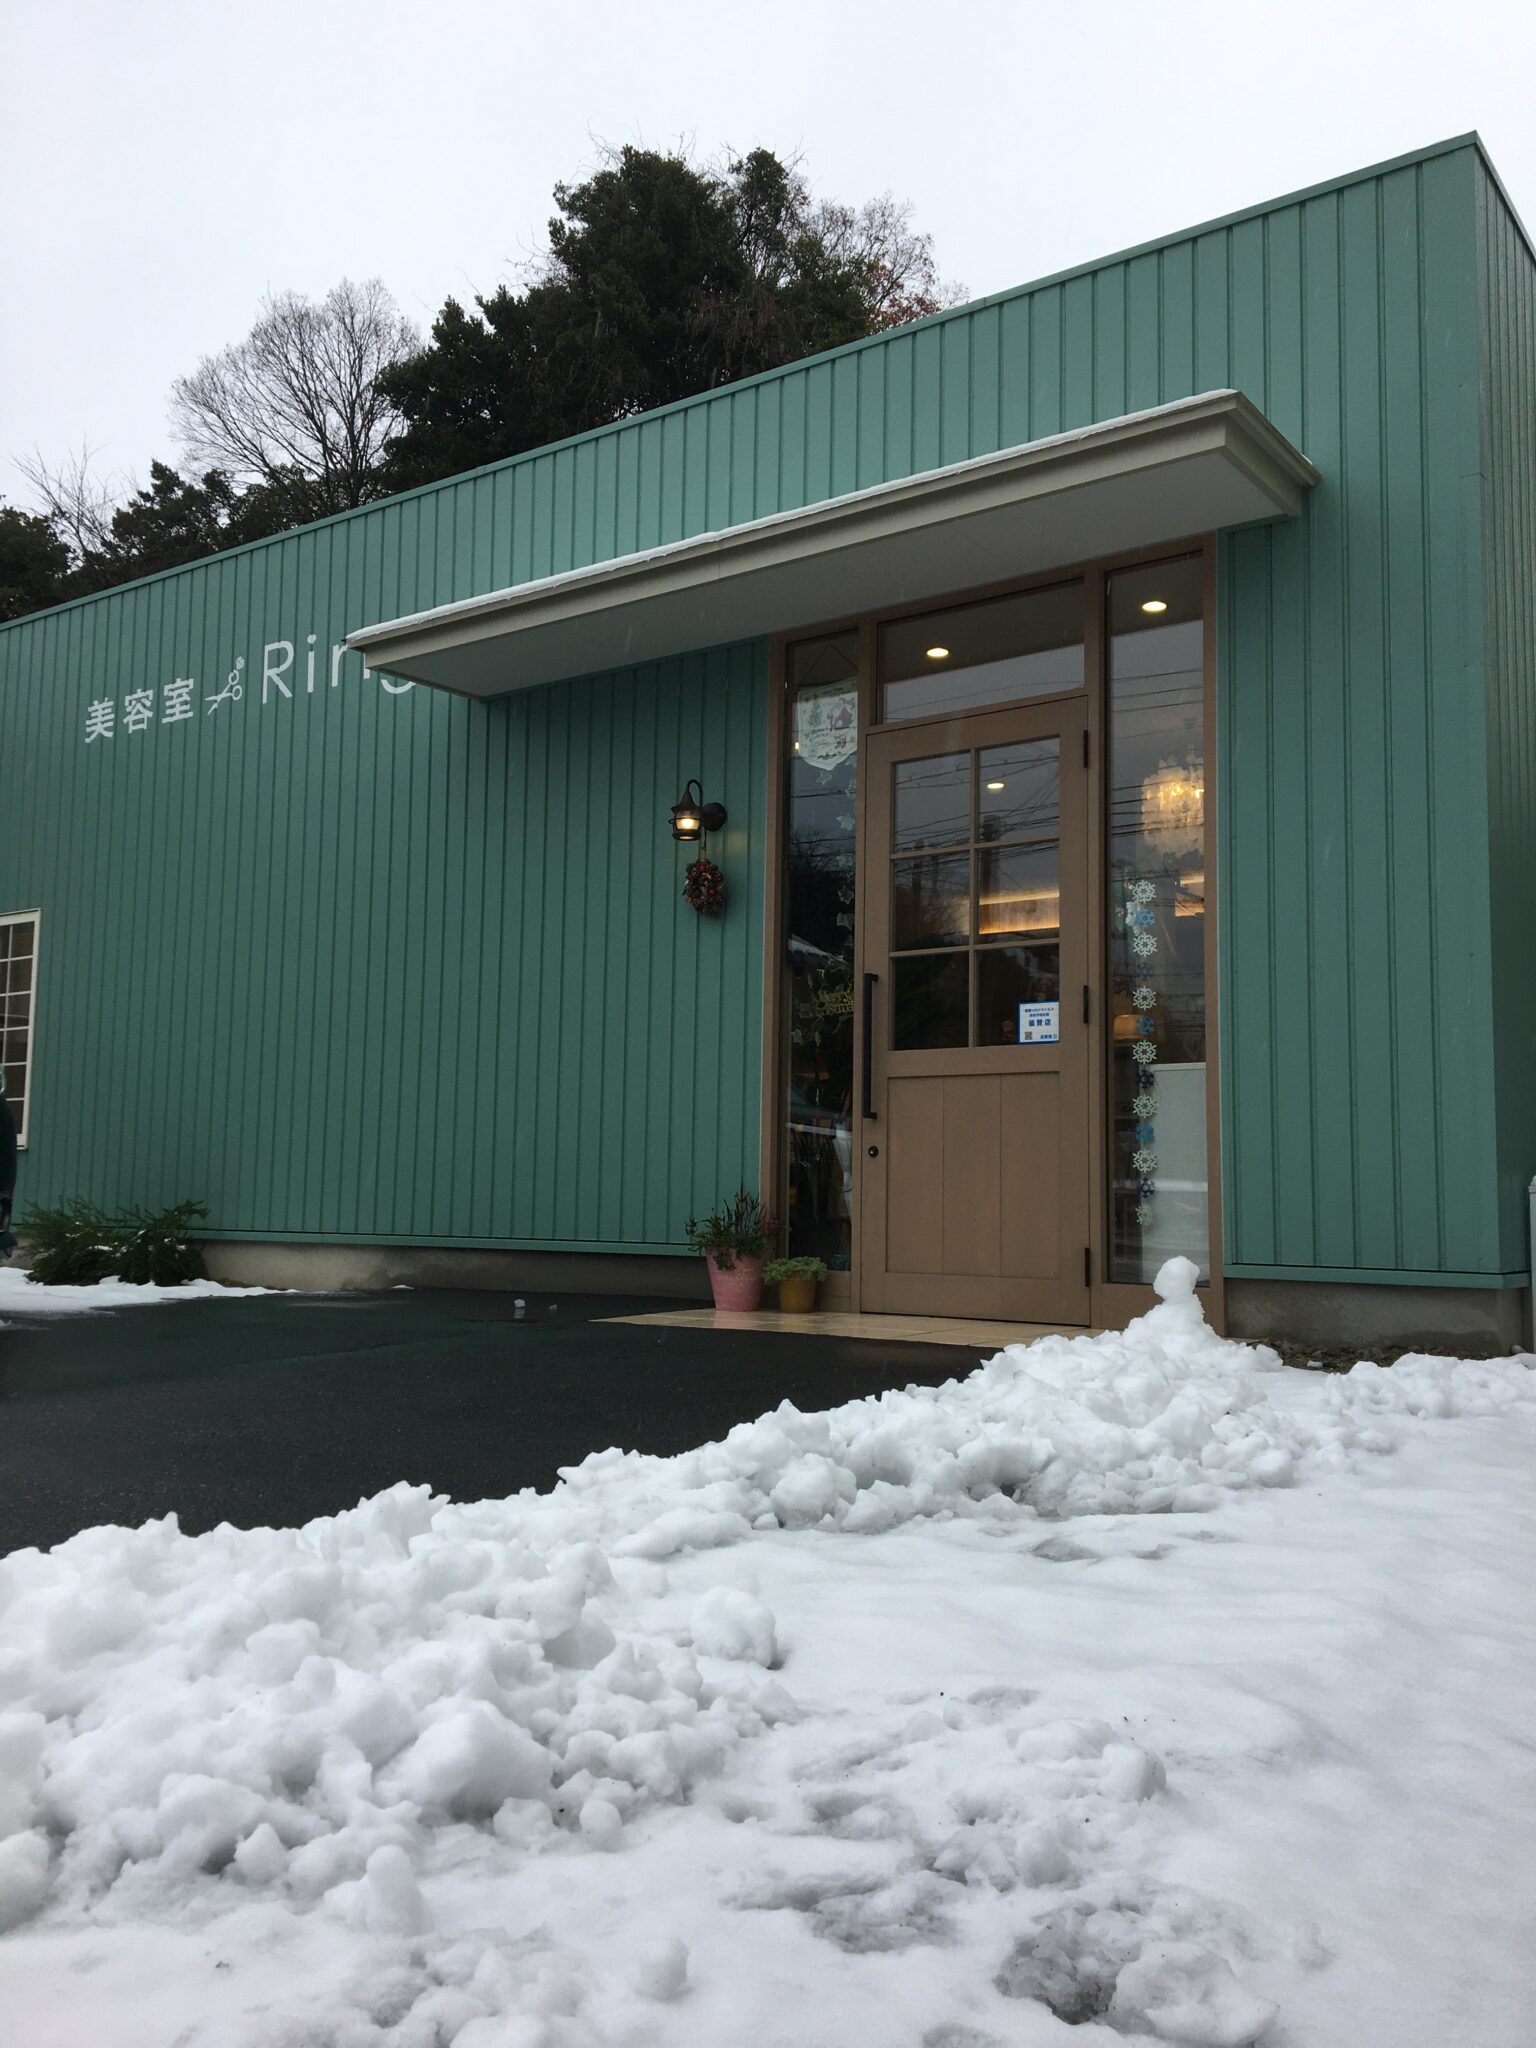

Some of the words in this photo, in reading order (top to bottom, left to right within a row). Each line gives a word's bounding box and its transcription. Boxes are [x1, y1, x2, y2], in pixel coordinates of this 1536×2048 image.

[85, 677, 194, 743] 美容室
[262, 634, 417, 704] Rin
